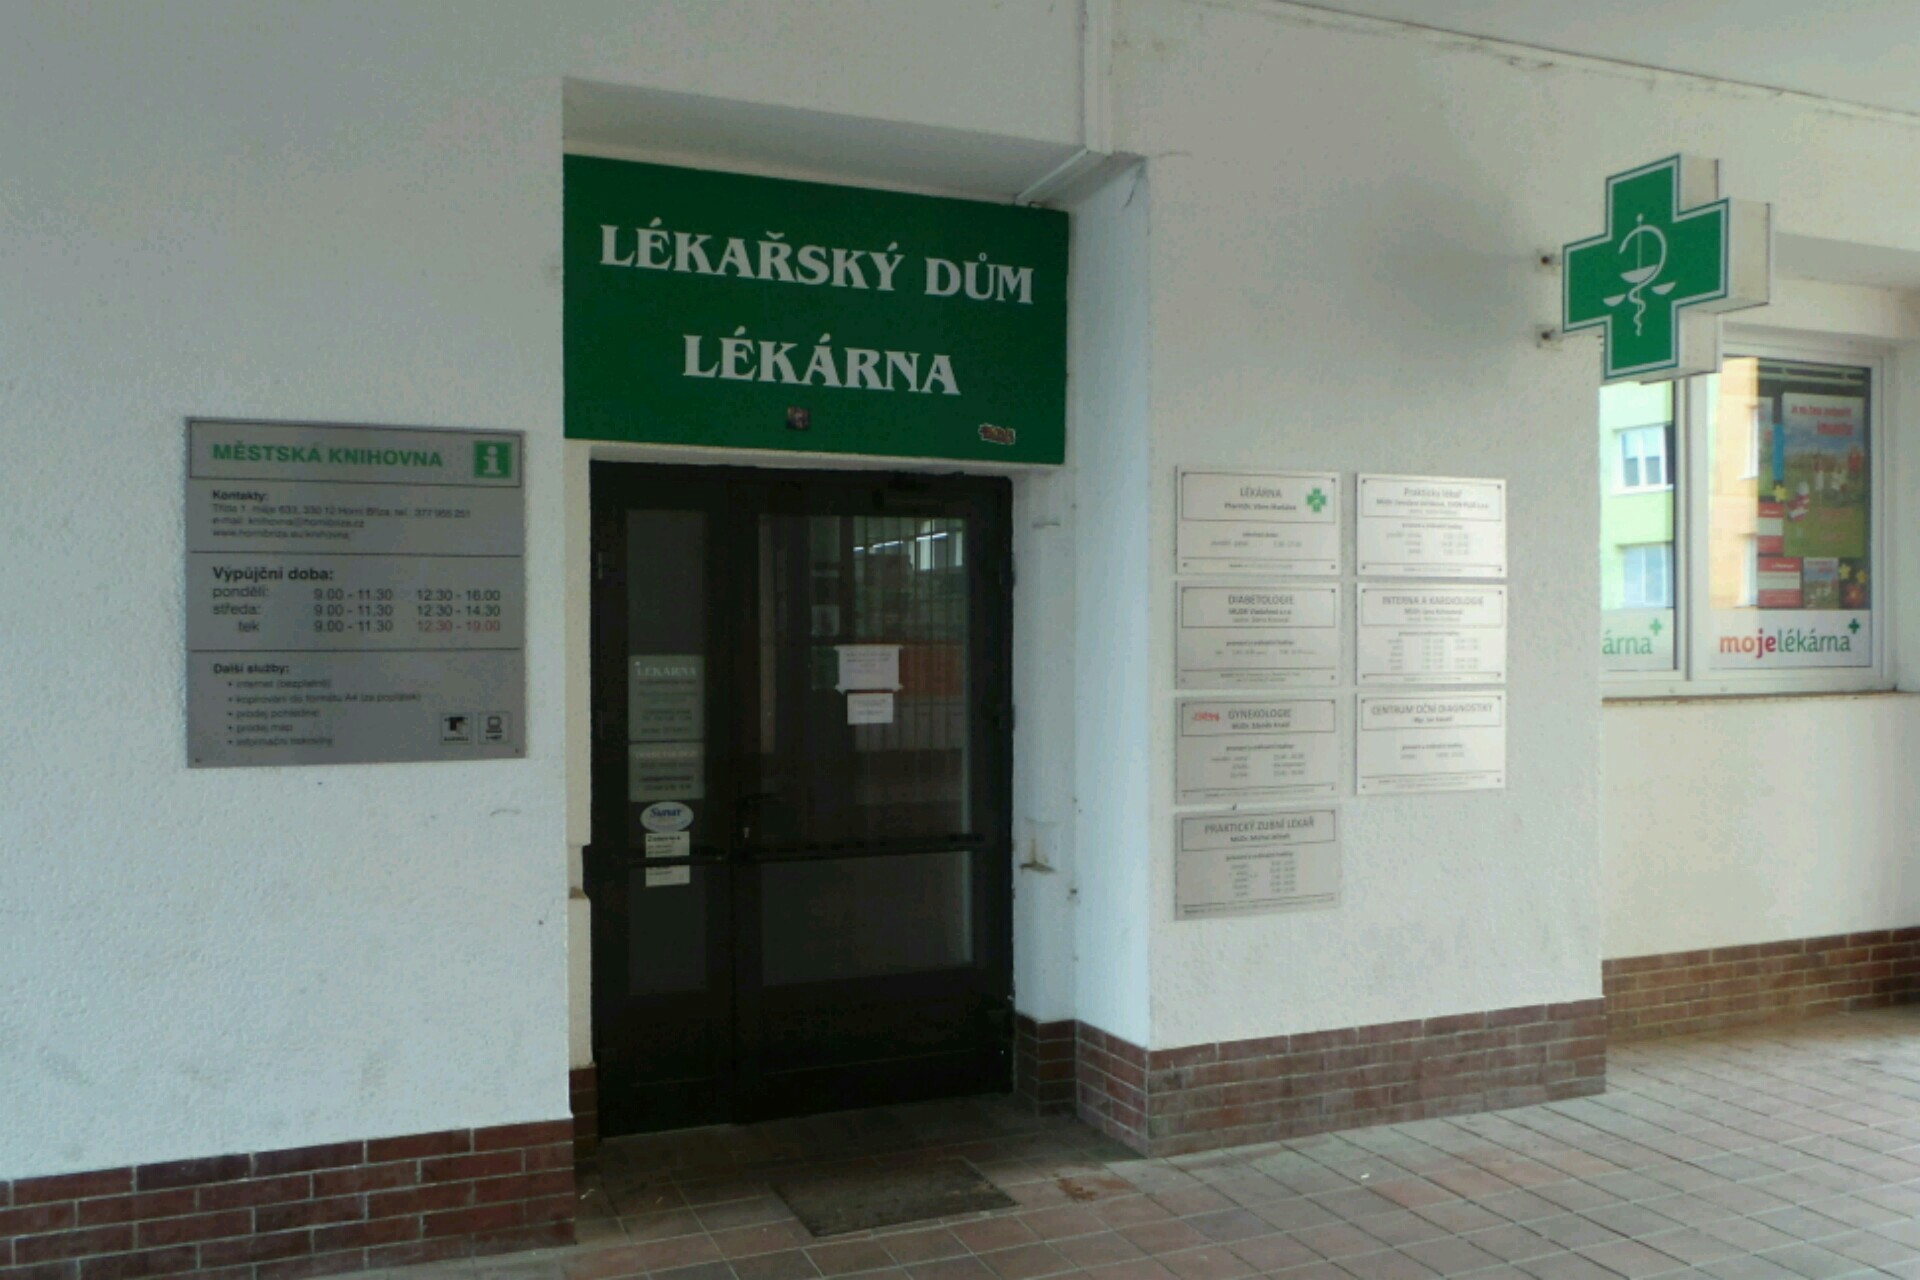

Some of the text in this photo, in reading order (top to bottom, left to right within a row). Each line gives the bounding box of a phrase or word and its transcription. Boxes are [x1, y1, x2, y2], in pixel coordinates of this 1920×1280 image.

[600, 217, 1034, 304] LÉKAŘSKÝ DŮM
[683, 325, 961, 395] LÉKÁRNA
[212, 441, 443, 467] MĚSTSKÁ KNIHOVNA
[212, 490, 268, 503] Kontakty:
[212, 565, 334, 583] Výpůjční doba:
[313, 588, 344, 601] 9.00
[357, 588, 393, 601] 11.30
[417, 588, 453, 601] 12.30
[313, 604, 344, 617] 9.00
[357, 604, 393, 617] 11.30
[417, 604, 453, 617] 12.30
[467, 604, 501, 617] 14.30
[313, 620, 344, 633] 9.00
[357, 620, 393, 633] 11.30
